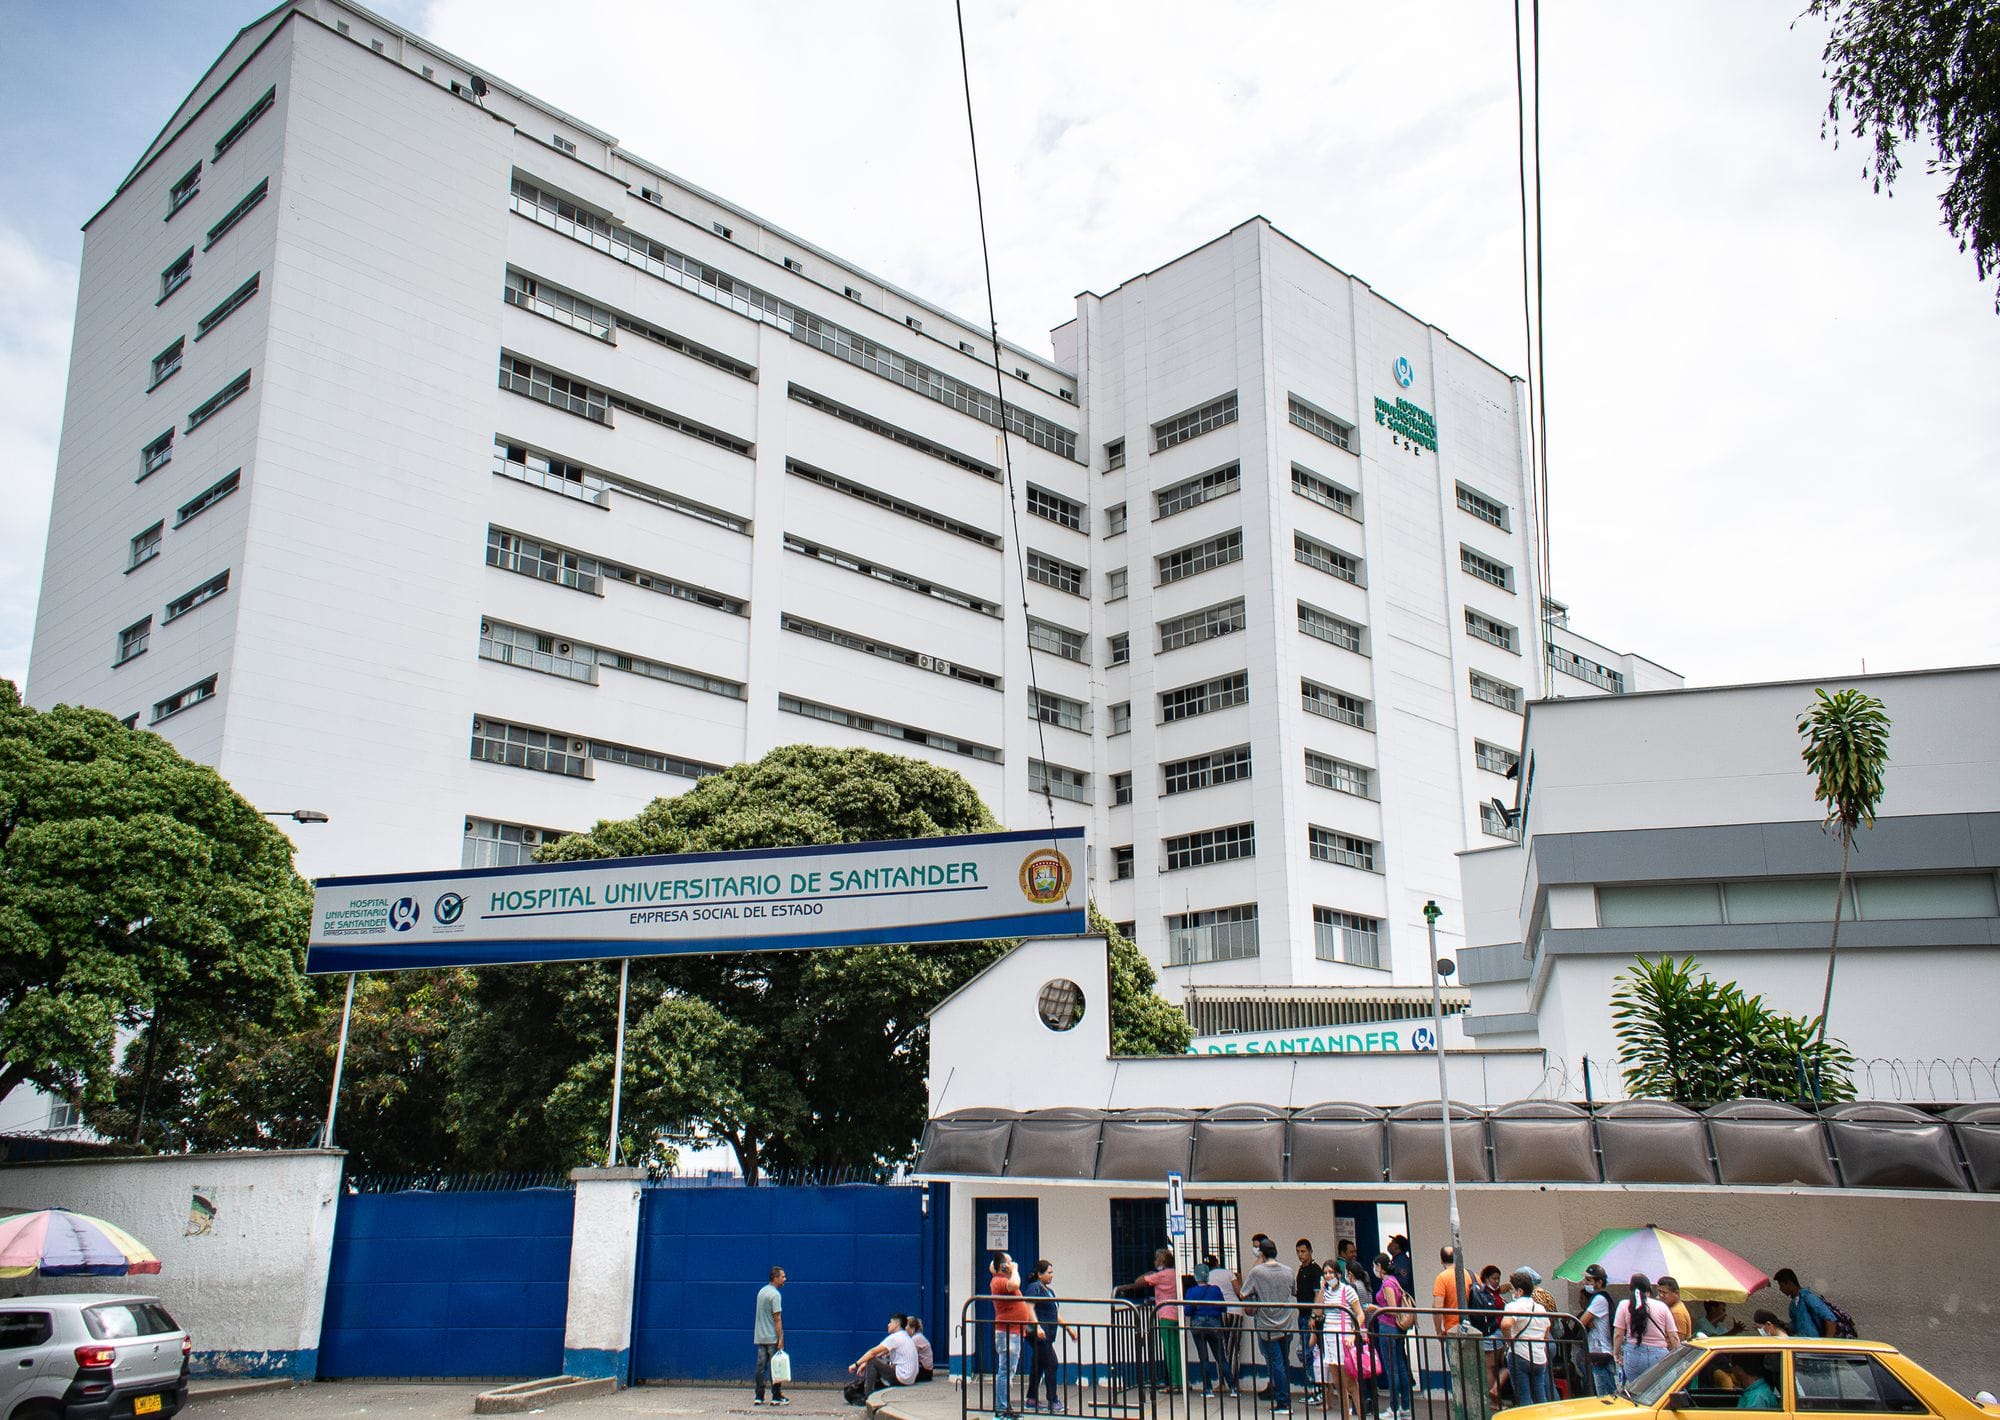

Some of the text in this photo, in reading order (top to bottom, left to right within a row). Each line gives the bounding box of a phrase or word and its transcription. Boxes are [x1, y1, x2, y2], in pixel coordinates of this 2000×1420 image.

[1396, 396, 1435, 427] HOSPITAL
[1387, 417, 1438, 453] SANTANDER
[491, 862, 978, 912] HOSPITAL UNIVERSITARIO DE SANTANDER
[326, 909, 387, 919] UNIVERSITARIO
[350, 899, 388, 908] HOSPITAL
[629, 903, 823, 925] EMPRESA SOCIAL DEL ESTADO
[324, 919, 387, 929] DE SANTANDER
[1246, 1031, 1401, 1053] SANTANDER
